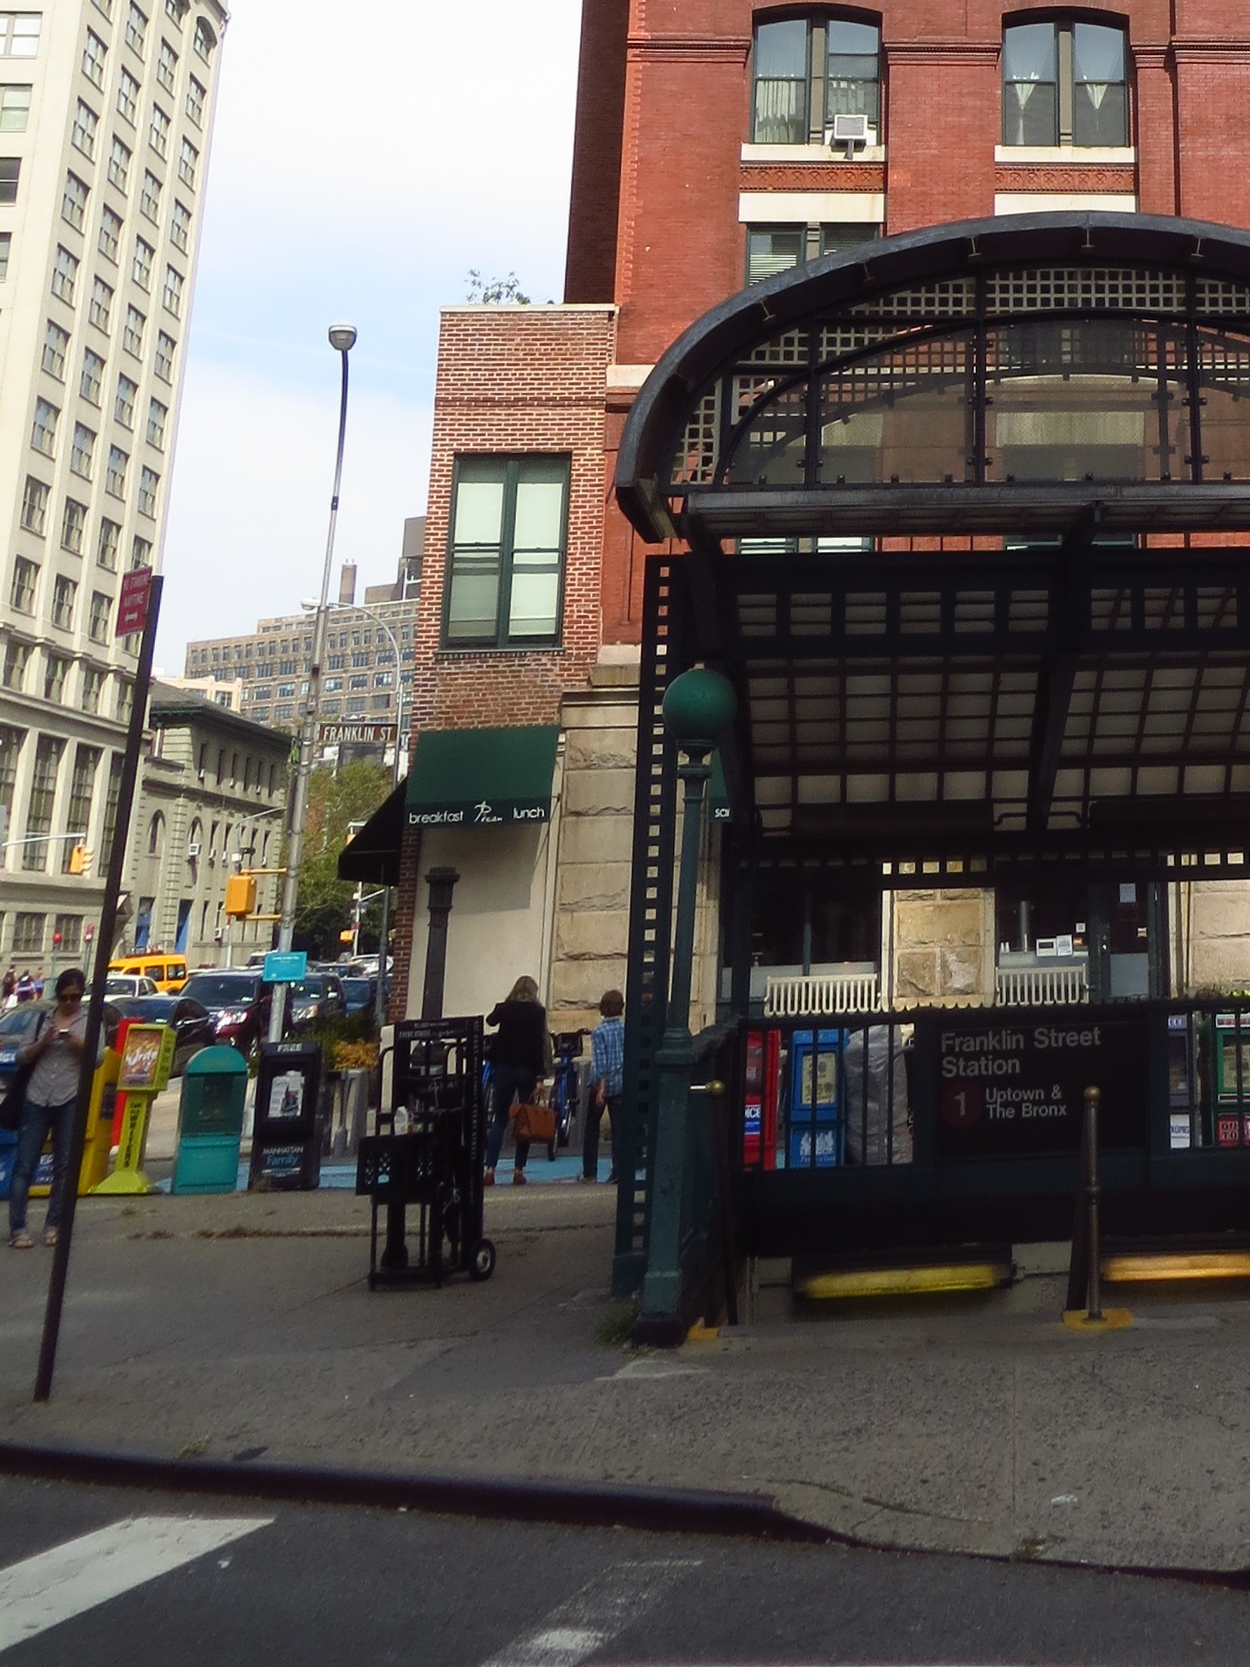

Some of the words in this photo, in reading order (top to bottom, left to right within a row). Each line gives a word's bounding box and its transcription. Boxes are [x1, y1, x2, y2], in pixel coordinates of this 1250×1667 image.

[323, 726, 375, 742] FRANKLIN
[379, 726, 393, 741] ST
[409, 810, 464, 824] breakfast
[513, 806, 545, 819] lunch
[277, 1043, 303, 1052] FREE
[941, 1029, 1024, 1052] Franklin
[1034, 1026, 1101, 1049] Street
[942, 1055, 1020, 1078] Station
[985, 1087, 1045, 1105] Uptown
[1051, 1084, 1062, 1100] &
[954, 1091, 966, 1116] 1
[986, 1103, 1015, 1119] The
[1021, 1102, 1067, 1118] Bronx
[262, 1146, 304, 1156] MANHATTAN
[267, 1154, 299, 1167] Family
